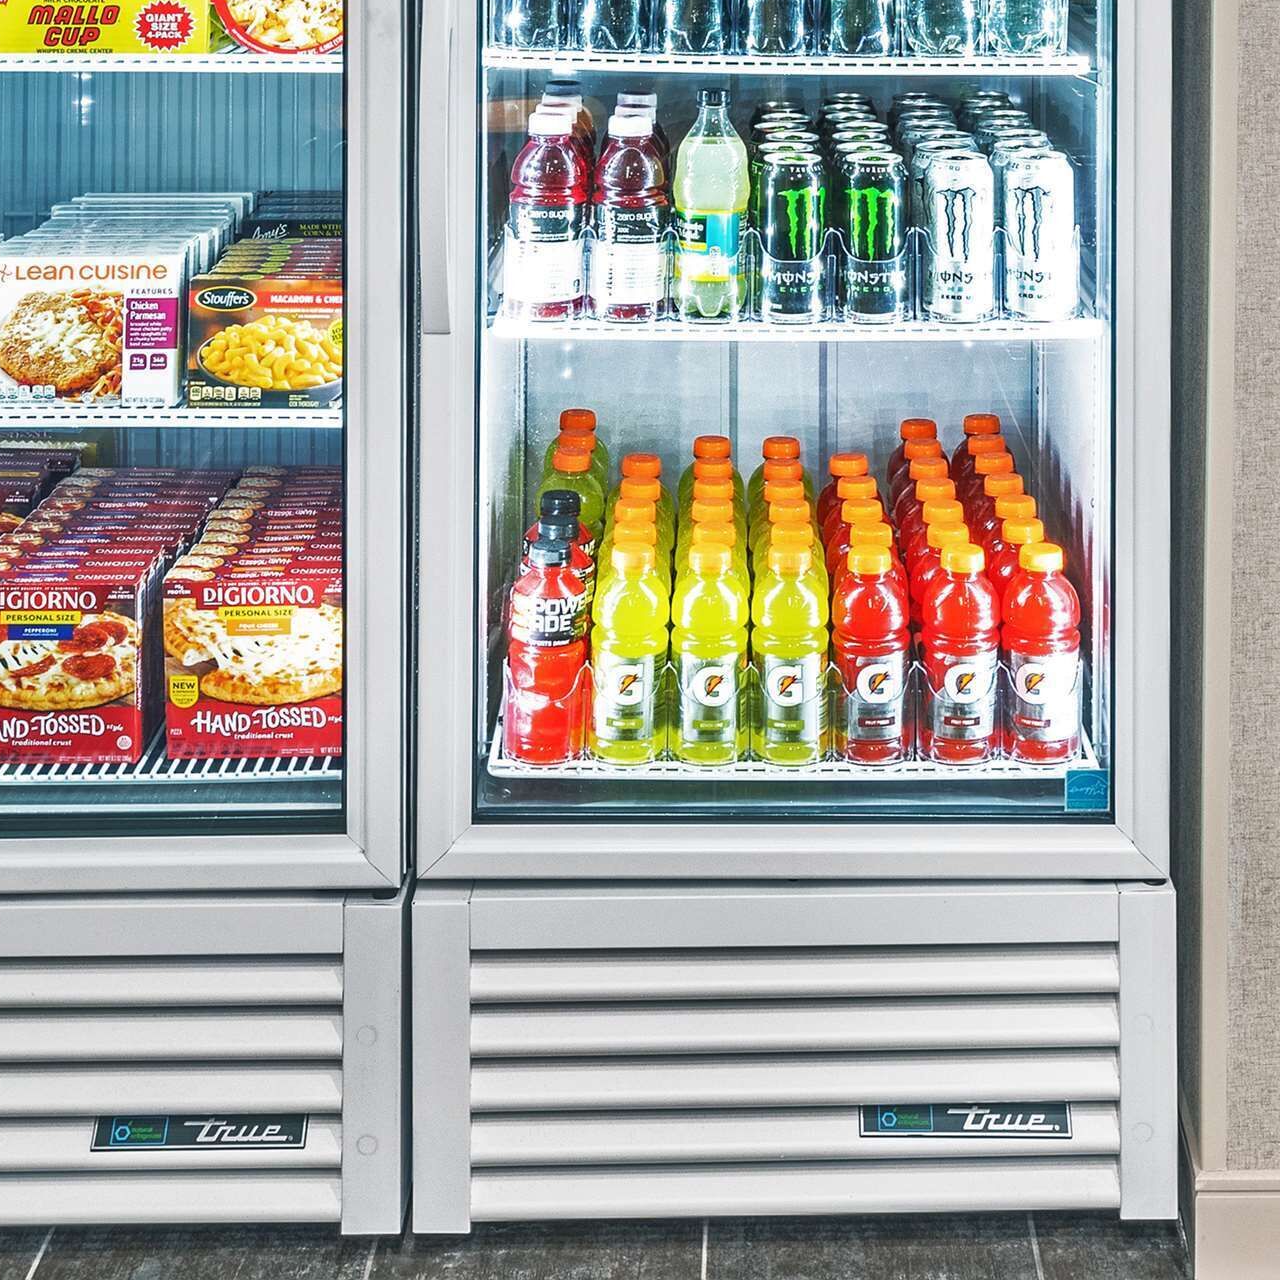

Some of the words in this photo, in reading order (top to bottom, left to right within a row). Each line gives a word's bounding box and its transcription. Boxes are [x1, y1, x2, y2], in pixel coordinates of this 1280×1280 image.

[28, 5, 121, 25] MALLO
[145, 13, 183, 23] GIANT
[151, 22, 178, 31] SIZE
[43, 27, 101, 47] CUP
[616, 212, 635, 221] zero
[201, 289, 251, 307] Stouffer's
[130, 300, 159, 310] Chicken
[130, 310, 166, 320] Parmesan
[224, 609, 272, 617] PERSONAL
[274, 608, 293, 616] SIZE
[172, 681, 196, 690] NEW
[190, 706, 327, 737] HAND-TOSSED
[234, 732, 274, 740] traditional
[274, 732, 294, 740] crust
[11, 738, 52, 746] traditional
[52, 738, 72, 746] crust
